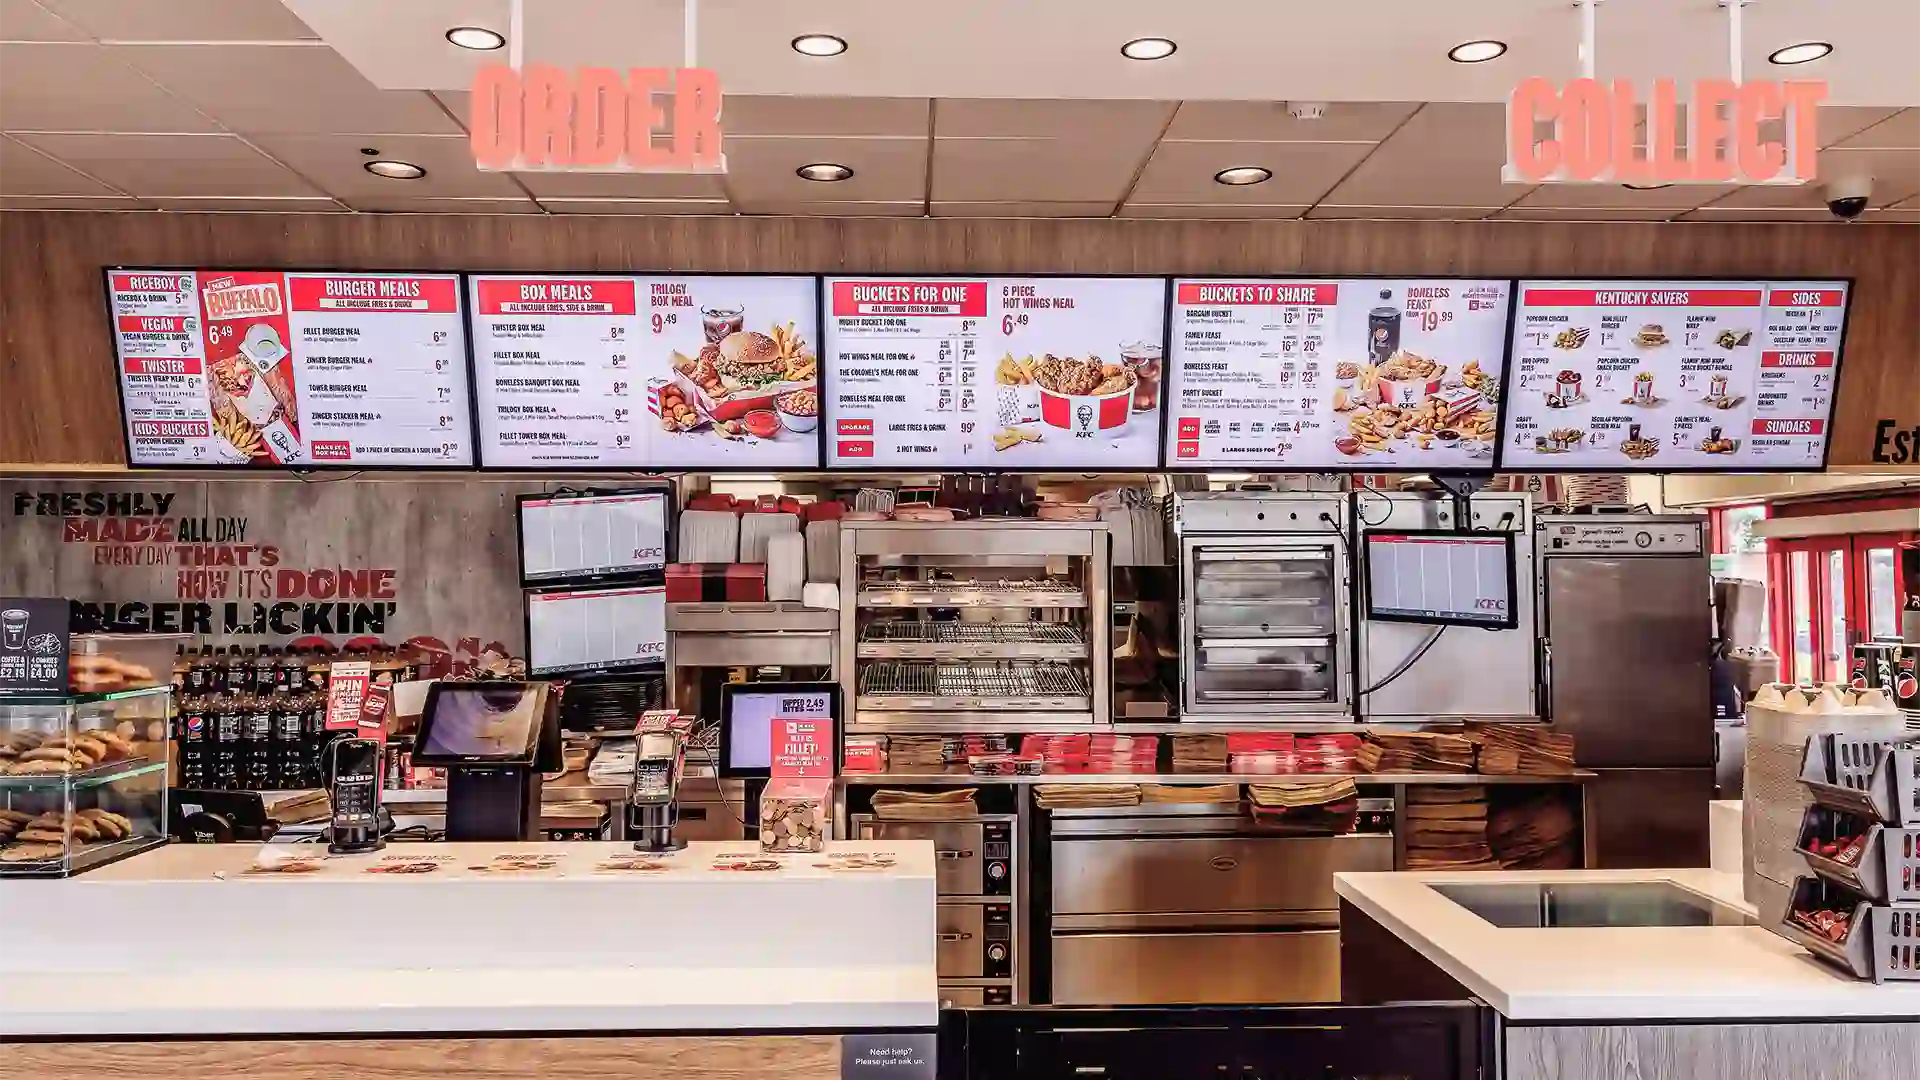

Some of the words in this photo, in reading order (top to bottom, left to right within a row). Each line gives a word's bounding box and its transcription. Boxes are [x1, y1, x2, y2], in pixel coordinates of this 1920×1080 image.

[470, 62, 723, 169] ORDER
[1508, 77, 1828, 181] COLLECT
[130, 276, 176, 290] RICEBOX
[211, 280, 232, 292] NEW
[325, 280, 376, 297] BURGER
[379, 280, 421, 297] MEALS
[650, 283, 688, 295] TRILOGY
[520, 284, 547, 300] BOX
[550, 284, 593, 300] MEALS
[853, 286, 910, 302] BUCKETS
[914, 286, 938, 302] FOR
[942, 286, 967, 302] ONE
[1002, 285, 1009, 297] 6
[1011, 285, 1036, 297] PIECE
[1200, 286, 1254, 302] BUCKETS
[1258, 287, 1273, 302] TO
[1276, 287, 1317, 303] SHARE
[1407, 287, 1450, 298] BONELESS
[206, 287, 279, 317] BUFFALO
[651, 295, 669, 307] BOX
[671, 295, 694, 307] MEAL
[1003, 297, 1020, 309] HOT
[1022, 297, 1051, 309] WINGS
[1052, 297, 1075, 309] MEAL
[1595, 291, 1648, 305] KENTUCKY
[1650, 291, 1689, 305] SAVERS
[1791, 292, 1821, 305] SIDES
[1406, 299, 1432, 310] FEAST
[140, 318, 175, 331] VEGAN
[491, 323, 517, 331] TWISTER
[517, 323, 530, 331] BOX
[530, 323, 546, 331] MEAL
[651, 313, 677, 334] 9.49
[1002, 313, 1029, 336] 6.49
[1420, 311, 1453, 332] 19.99
[122, 333, 141, 341] VEGAN
[208, 325, 233, 345] 6.49
[303, 327, 321, 336] FILLET
[322, 327, 347, 336] BURGER
[347, 327, 361, 336] MEAL
[1204, 331, 1222, 339] FEAST
[306, 356, 327, 364] ZINGER
[327, 356, 351, 364] BURGER
[351, 356, 366, 364] MEAL
[493, 351, 512, 359] FILLET
[512, 351, 524, 359] BOX
[525, 351, 540, 359] MEAL
[839, 352, 851, 360] HOT
[851, 352, 870, 360] WINGS
[870, 352, 885, 360] MEAL
[886, 352, 897, 360] FOR
[898, 352, 909, 360] ONE
[1779, 353, 1817, 366] DRINKS
[140, 360, 185, 373] TWISTER
[1183, 362, 1210, 370] BONELESS
[1211, 362, 1229, 370] FEAST
[839, 369, 850, 377] THE
[850, 369, 880, 377] COLONEL'S
[881, 369, 895, 377] MEAL
[895, 369, 907, 377] FOR
[908, 369, 919, 377] ONE
[308, 384, 328, 392] TOWER
[329, 384, 351, 392] BURGER
[352, 384, 368, 392] MEAL
[495, 378, 524, 387] BONELESS
[525, 378, 552, 387] BANQUET
[552, 378, 564, 387] BOX
[564, 378, 580, 387] MEAL
[839, 394, 867, 402] BONELESS
[867, 394, 882, 402] MEAL
[883, 394, 894, 402] FOR
[895, 394, 906, 402] ONE
[1182, 389, 1201, 397] PARTY
[1201, 389, 1223, 397] BUCKET
[498, 405, 521, 413] TRILOGY
[522, 405, 534, 413] BOX
[535, 405, 550, 413] MEAL
[311, 412, 333, 421] ZINGER
[333, 412, 359, 421] STACKER
[360, 412, 375, 421] MEAL
[135, 423, 159, 436] KIDS
[161, 423, 206, 436] BUCKETS
[888, 424, 906, 432] LARGE
[906, 424, 923, 432] FRIES
[929, 424, 947, 432] DRINK
[1765, 420, 1811, 433] SUNDAES
[499, 432, 518, 440] FILLET
[518, 432, 538, 440] TOWER
[538, 432, 551, 440] BOX
[551, 432, 567, 440] MEAL
[896, 445, 901, 453] 2
[901, 445, 913, 453] HOT
[913, 445, 932, 453] WINGS
[284, 449, 302, 464] KFC
[13, 492, 178, 517] FRESHLY
[62, 516, 176, 543] MADE
[177, 516, 213, 543] ALL
[215, 516, 248, 543] DAY
[94, 545, 142, 566] EVERY
[147, 545, 173, 566] DAY
[175, 543, 280, 567] THAT'S
[632, 547, 662, 559] KFC
[177, 568, 230, 600] HOW
[238, 568, 273, 600] IT'S
[276, 566, 397, 600] DONE
[1474, 599, 1505, 611] KFC
[224, 601, 397, 635] LICKIN'
[635, 642, 665, 654] KFC
[0, 667, 25, 678] £2.19
[31, 668, 58, 679] £4.00
[333, 679, 363, 691] WIN
[806, 698, 825, 708] 2.49
[784, 743, 819, 755] FILLET!
[869, 1048, 890, 1056] Need
[891, 1048, 913, 1057] help?
[881, 1058, 897, 1066] just
